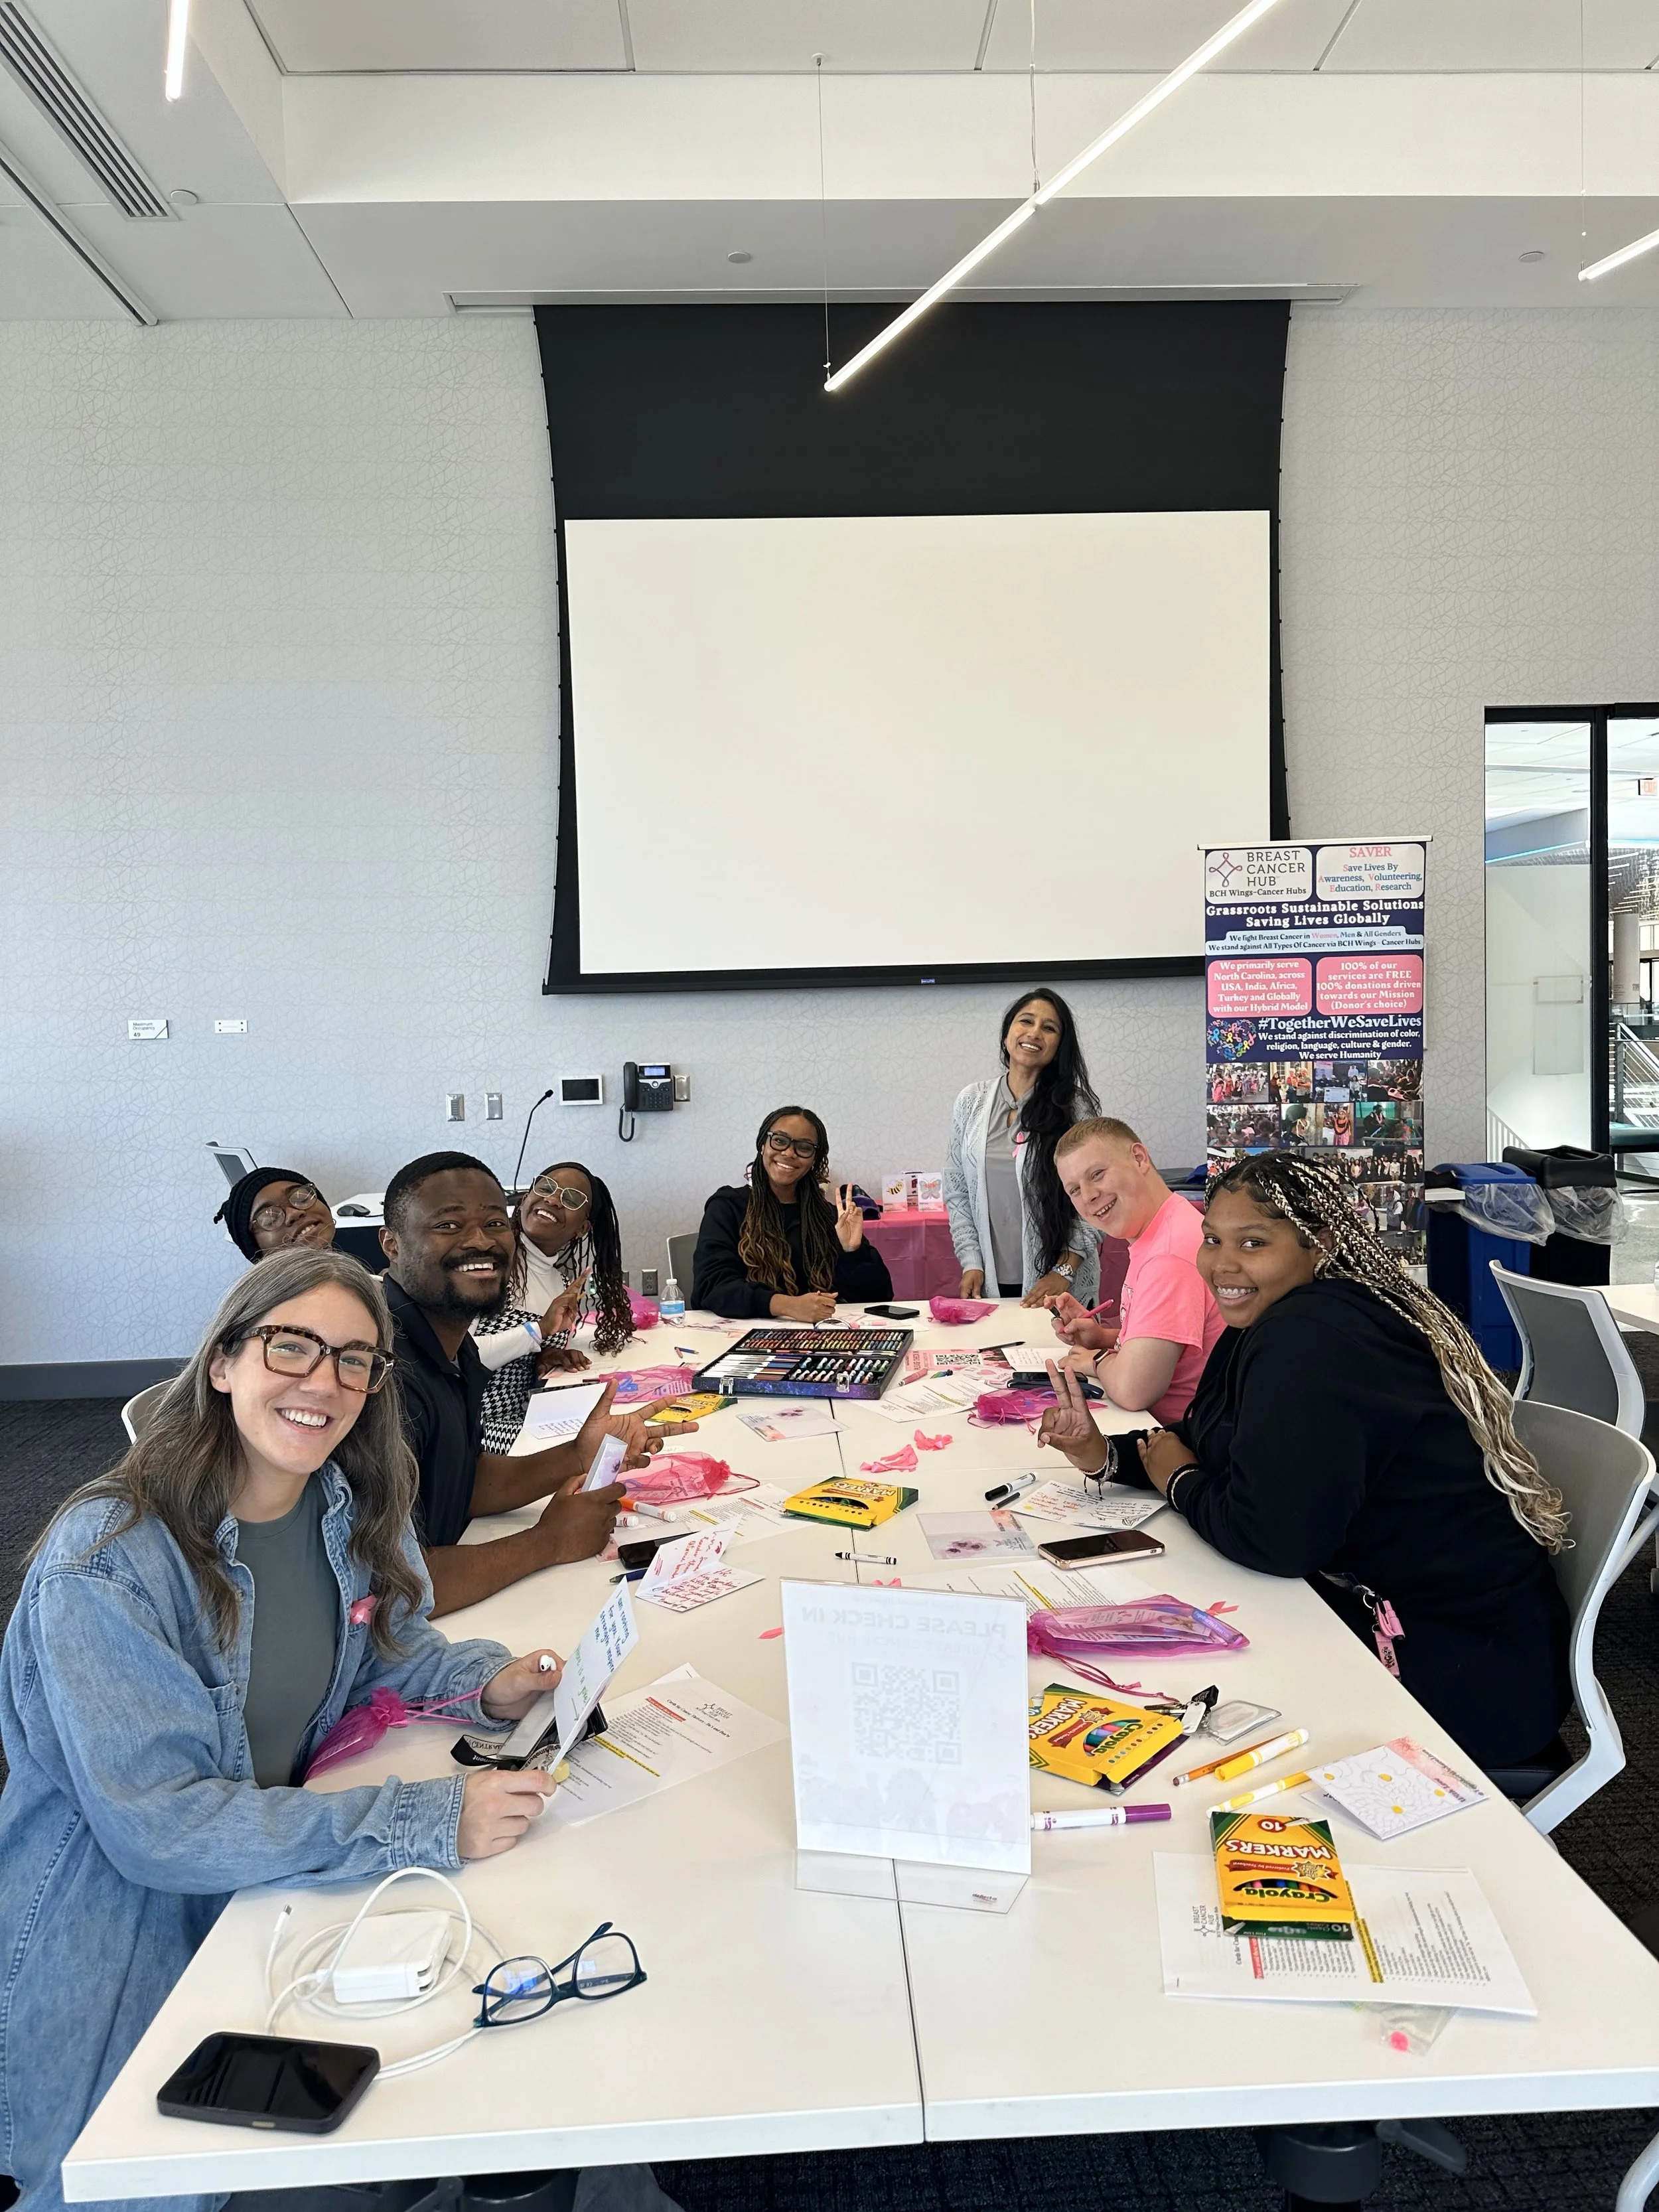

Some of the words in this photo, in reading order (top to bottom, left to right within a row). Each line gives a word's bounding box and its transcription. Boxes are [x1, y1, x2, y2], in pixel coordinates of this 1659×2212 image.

[1247, 850, 1300, 862] BREAST
[1349, 846, 1392, 857] SAVER
[1247, 862, 1305, 874] CANCER
[1387, 863, 1398, 872] By
[1247, 876, 1276, 887] HUB
[1368, 872, 1422, 881] Volunteering,
[1228, 888, 1284, 897] Wings-Cancer
[1330, 884, 1373, 893] Education,
[1206, 905, 1277, 916] Grassroots
[1281, 901, 1358, 913] Sustainable
[1363, 899, 1423, 911] Solutions
[1246, 917, 1290, 928] Saving
[1294, 915, 1329, 925] Lives
[1333, 912, 1390, 925] Globally
[1237, 960, 1275, 972] primarily
[1340, 962, 1367, 970] 100%
[1369, 961, 1379, 970] of
[1214, 972, 1240, 981] North
[1241, 971, 1277, 980] Carolina,
[1386, 970, 1411, 979] FREE
[1221, 983, 1244, 992] USA,
[1245, 982, 1268, 991] India,
[1269, 982, 1297, 990] Africa,
[1317, 982, 1342, 991] 100%
[1345, 981, 1391, 990] donations
[1218, 994, 1249, 1003] Turkey
[1267, 992, 1301, 1001] Globally
[1320, 991, 1358, 1000] towards
[1378, 990, 1415, 998] Mission
[1212, 1004, 1232, 1013] with
[1250, 1003, 1279, 1013] Hybrid
[1281, 1002, 1308, 1011] Model
[1331, 1000, 1372, 1010] (Donor's
[1374, 999, 1407, 1008] choice)
[1258, 1015, 1421, 1033] #TogetherWeSaveLives
[1297, 1031, 1327, 1041] against
[1328, 1030, 1389, 1039] discrimination
[1390, 1029, 1399, 1037] of
[1400, 1029, 1420, 1037] color,
[1266, 1042, 1300, 1052] religion,
[1301, 1041, 1339, 1051] language,
[1382, 1039, 1412, 1050] gender.
[1340, 1050, 1382, 1060] Humanity
[835, 1482, 895, 1496] MARKERS
[616, 1589, 622, 1599] I
[617, 1597, 624, 1611] am
[620, 1611, 630, 1645] rooting
[1029, 1698, 1088, 1740] MARKERS
[1094, 1724, 1144, 1754] Crayola
[1262, 1820, 1283, 1832] 10
[1226, 1839, 1332, 1859] MARKERS
[1245, 1887, 1330, 1903] Crayola
[1331, 1924, 1349, 1933] 10
